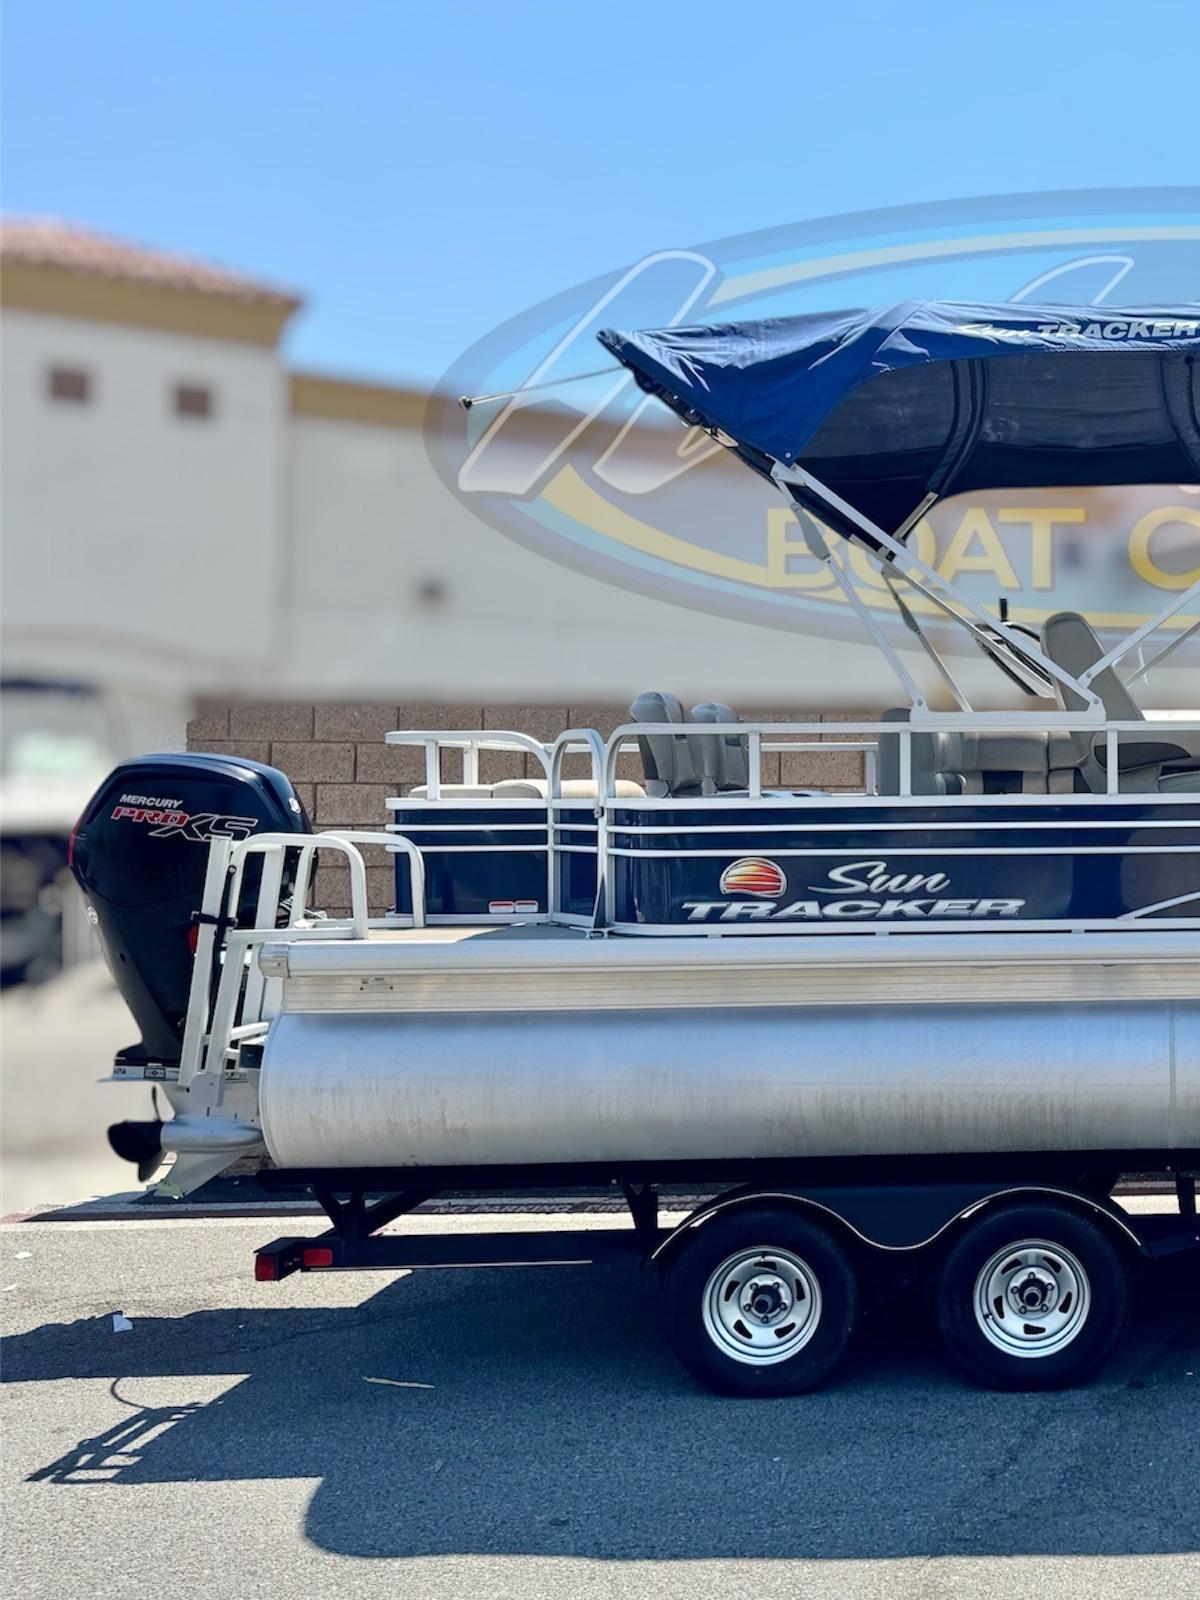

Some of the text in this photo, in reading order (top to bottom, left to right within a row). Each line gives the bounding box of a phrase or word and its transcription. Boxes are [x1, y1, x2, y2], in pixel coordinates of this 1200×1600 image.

[1037, 320, 1199, 339] TRACKER
[119, 793, 184, 809] MERCURY
[110, 806, 258, 842] PRO XS
[807, 860, 951, 894] Sun
[682, 898, 1027, 921] TRACKER
